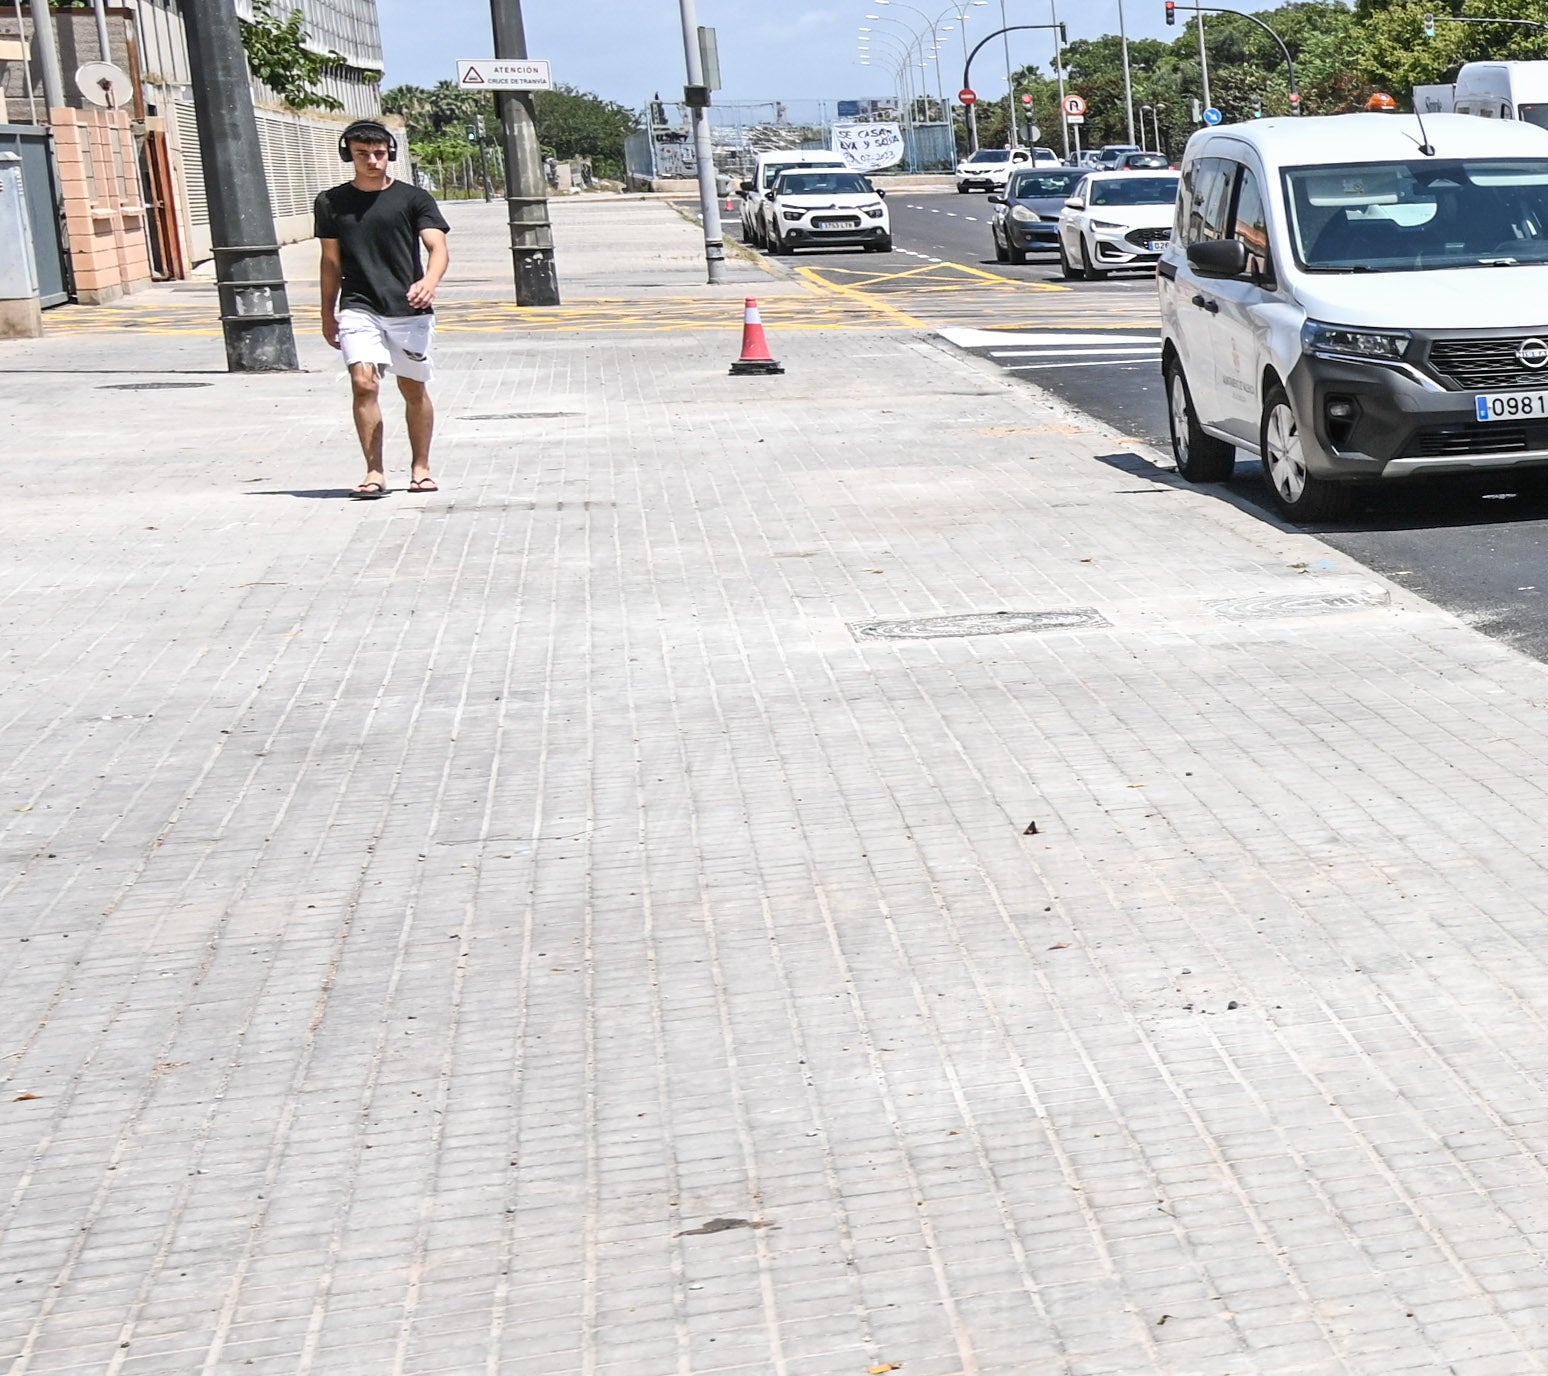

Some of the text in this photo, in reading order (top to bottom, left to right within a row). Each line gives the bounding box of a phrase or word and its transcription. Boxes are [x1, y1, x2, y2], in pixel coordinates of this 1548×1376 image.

[494, 66, 539, 74] ATENCIÓN
[839, 130, 852, 139] SE
[840, 141, 858, 150] EVA
[1492, 395, 1545, 416] 0981
